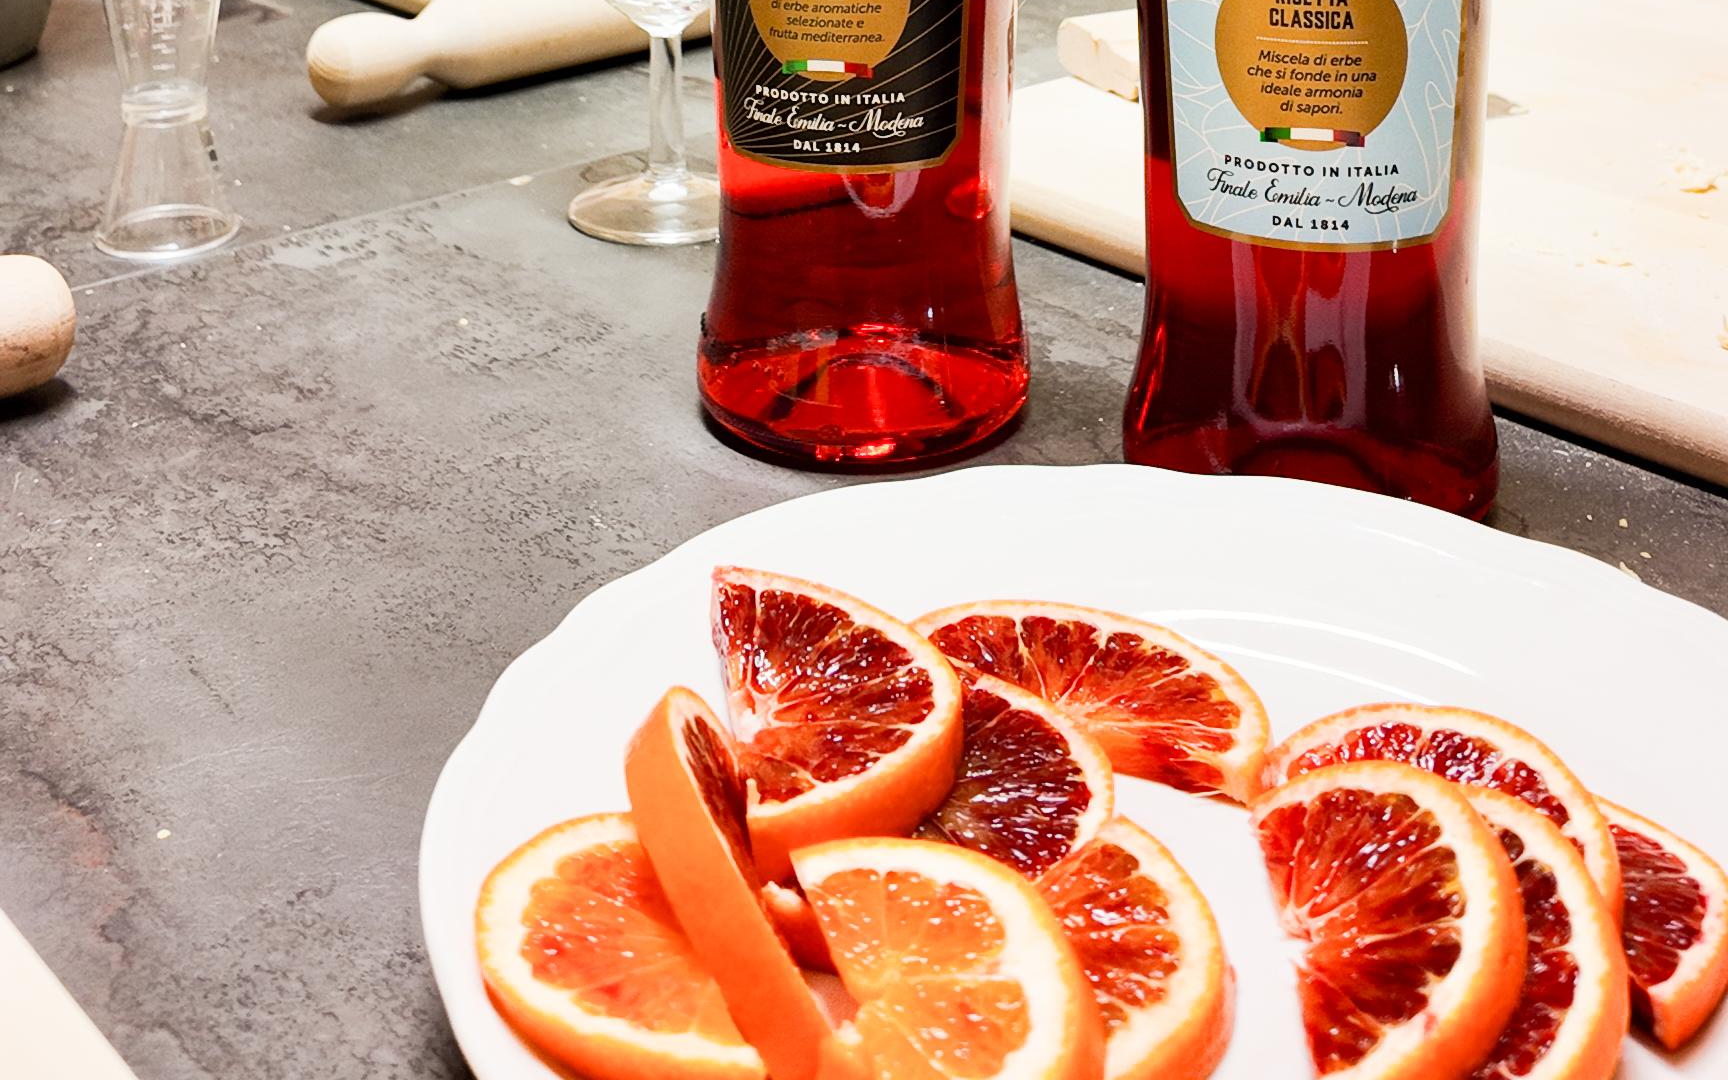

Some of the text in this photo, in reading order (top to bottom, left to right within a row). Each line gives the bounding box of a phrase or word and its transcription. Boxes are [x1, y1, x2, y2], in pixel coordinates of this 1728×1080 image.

[771, 0, 882, 14] di erbe aromatiche
[786, 16, 865, 29] selezionate e
[1269, 8, 1354, 29] CLASSICA
[769, 27, 885, 44] frutta mediterranea.
[1258, 49, 1363, 66] Miscela di erbe
[1247, 65, 1377, 82] che si fonde in una
[755, 85, 906, 105] PRODOTTO IN ITALIA
[1261, 83, 1363, 99] ideale armonia
[1280, 100, 1343, 117] di sapori.
[743, 97, 783, 126] Finale
[787, 105, 835, 132] Emilia
[849, 108, 924, 139] Modena
[793, 139, 861, 153] DAL 1814
[1224, 155, 1399, 178] PRODOTTO IN ITALIA
[1207, 168, 1258, 200] Finale
[1264, 179, 1321, 207] Emilia
[1338, 182, 1418, 215] Modena
[1272, 216, 1350, 231] DAL 1814
